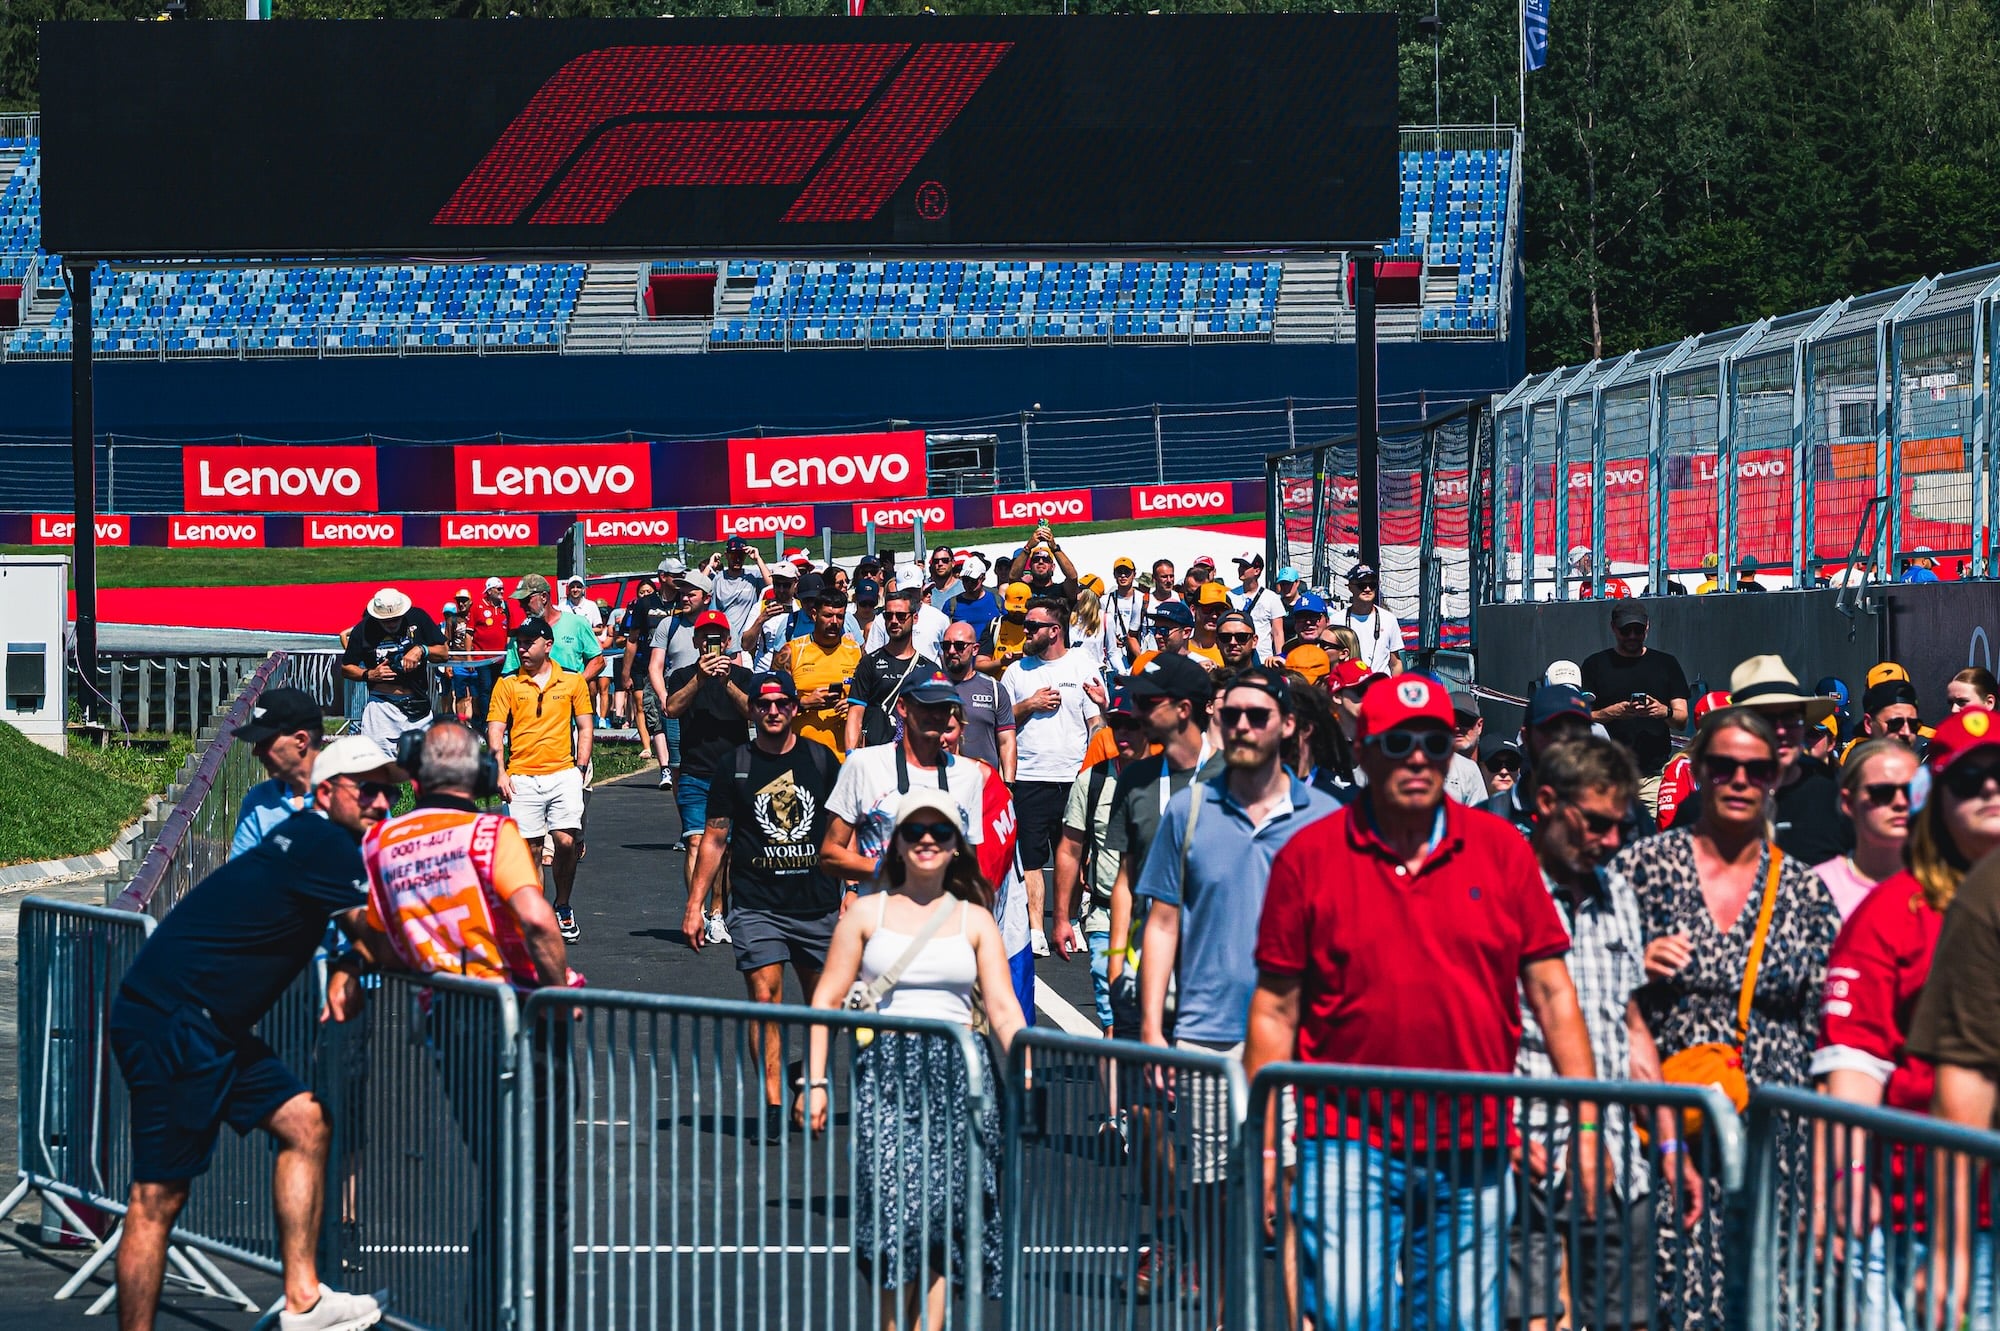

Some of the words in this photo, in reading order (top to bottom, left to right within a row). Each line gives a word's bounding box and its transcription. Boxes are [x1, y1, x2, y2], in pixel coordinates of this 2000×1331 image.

[199, 461, 361, 496] Lenovo
[472, 460, 635, 495] Lenovo
[745, 453, 910, 488] Lenovo
[1568, 469, 1644, 488] eovo
[1701, 461, 1784, 480] Lovo
[998, 499, 1084, 518] Lenovo
[1139, 491, 1225, 511] Lenovo
[722, 514, 807, 534] Lenovo
[861, 507, 946, 527] Lenovo
[40, 518, 122, 539] Lenvo
[174, 521, 257, 541] Lenovo
[311, 520, 395, 540] Lenovo
[447, 520, 531, 540] Lenovo
[585, 518, 670, 538] Lenovo
[763, 843, 816, 858] WORLD
[751, 854, 819, 869] CHAMPIO
